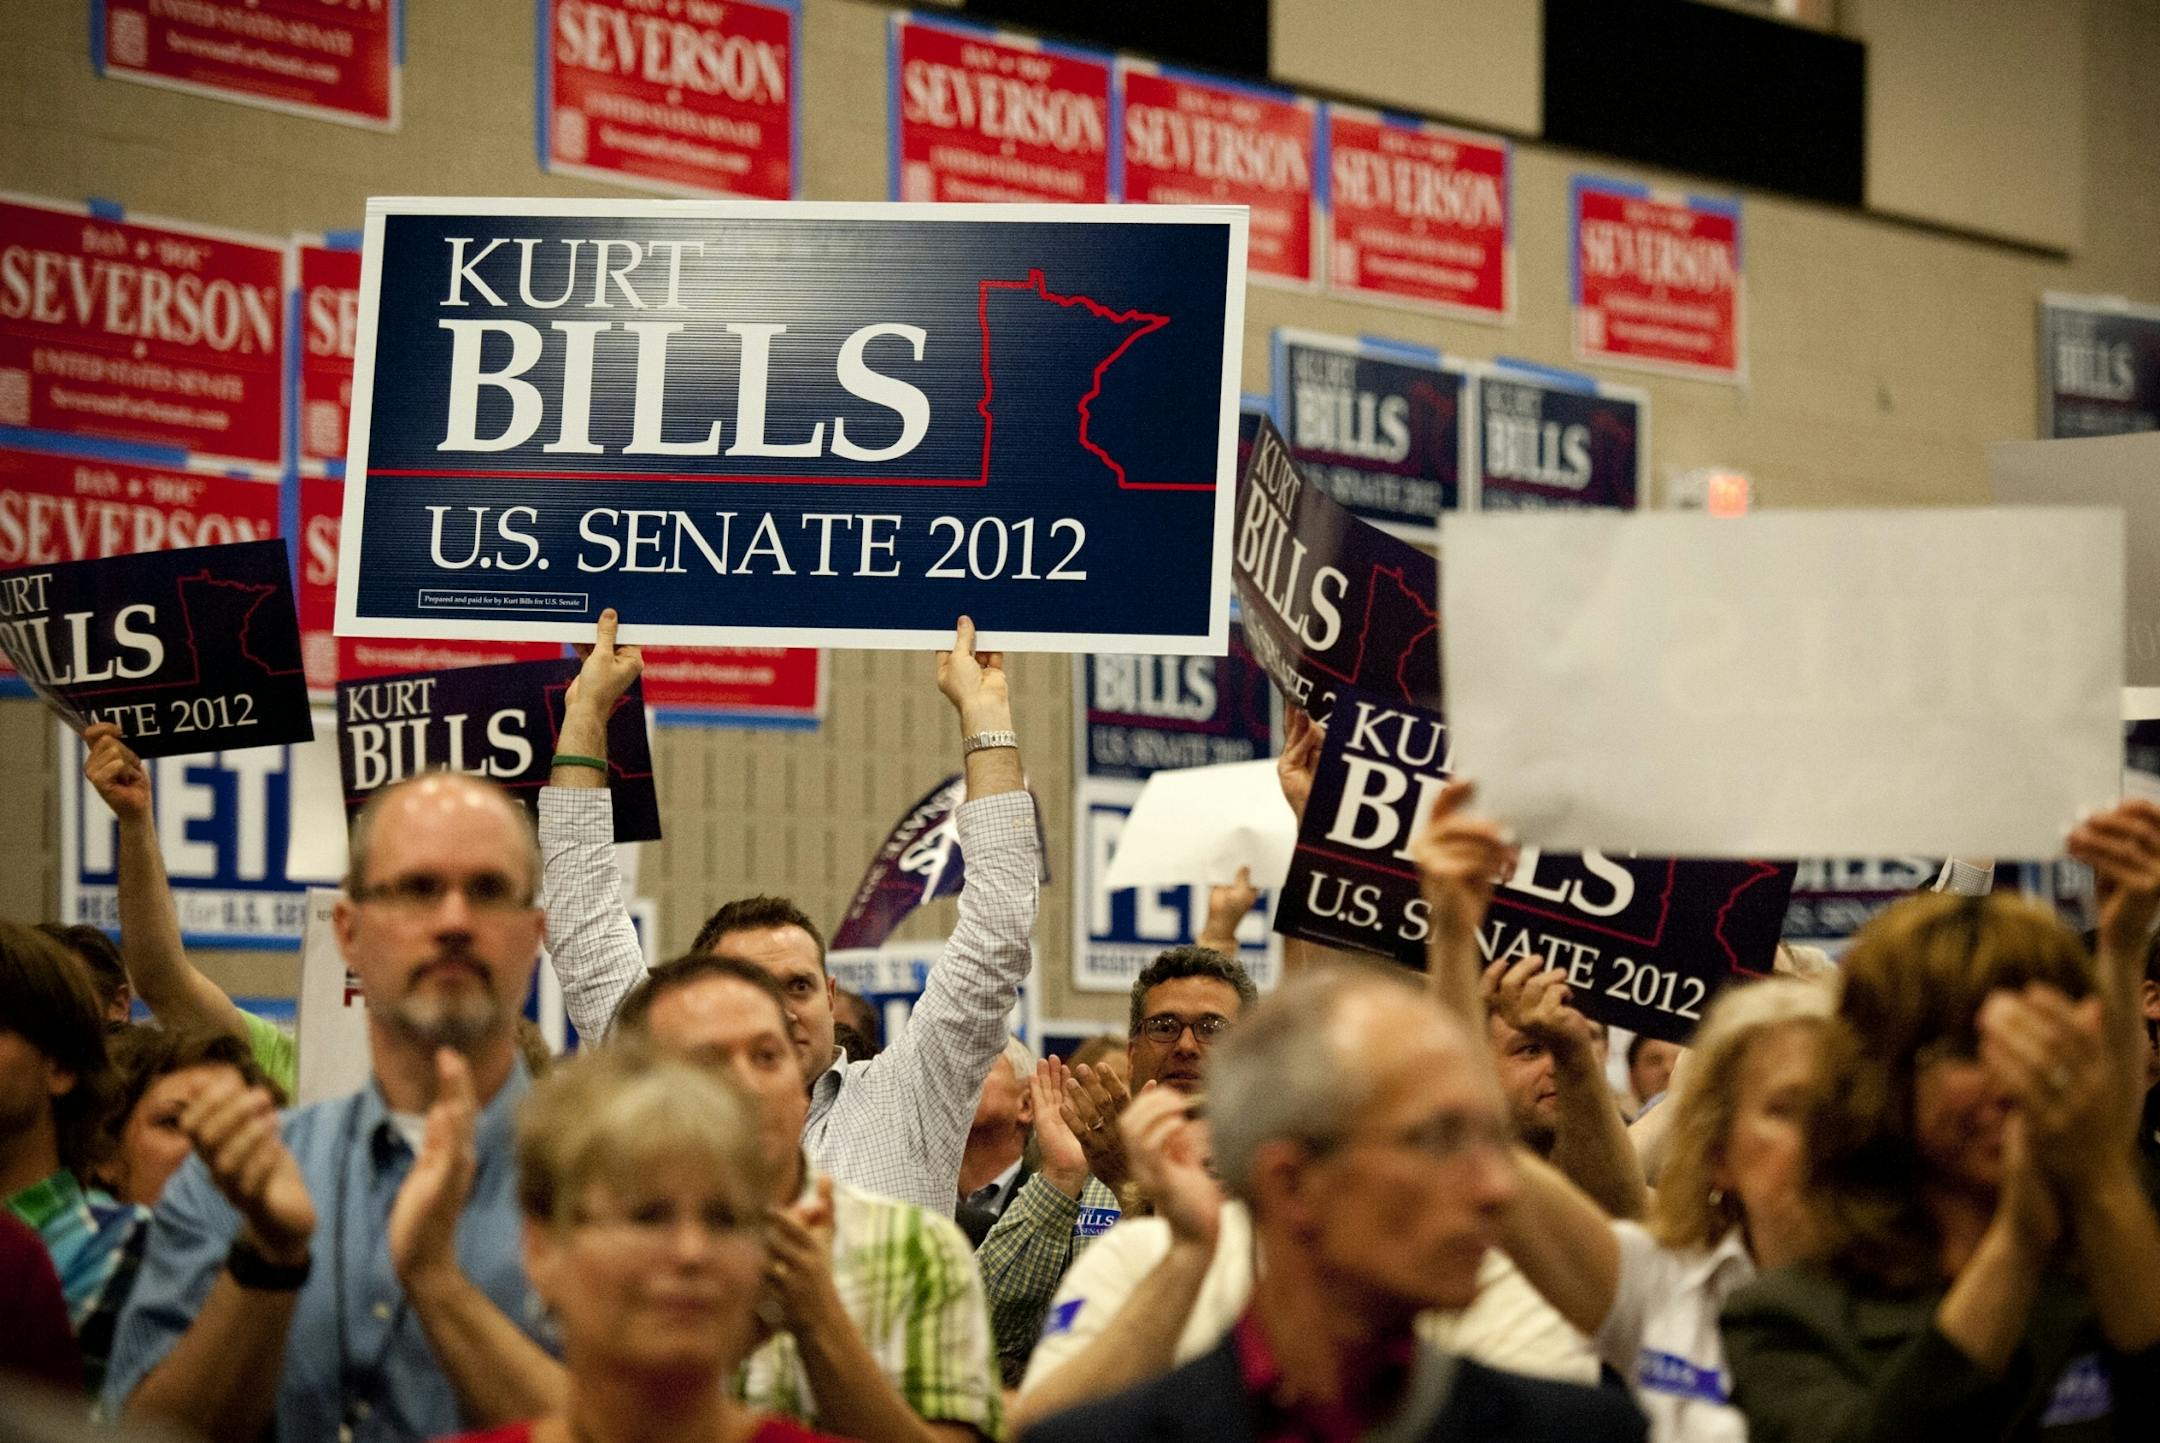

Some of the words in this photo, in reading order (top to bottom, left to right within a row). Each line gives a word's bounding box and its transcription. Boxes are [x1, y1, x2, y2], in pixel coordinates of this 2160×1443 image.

[556, 1, 786, 103] SEVERSON
[1, 244, 274, 354] SEVERSON
[439, 237, 704, 310] KURT
[437, 319, 930, 462] BILLS
[1254, 430, 1301, 520] KURT
[425, 505, 549, 571] U.S.
[576, 508, 902, 577] SENATE
[925, 516, 1087, 581] 2012
[1237, 480, 1349, 651] BILLS
[0, 574, 52, 616] URT
[424, 595, 453, 604] Prepared
[454, 595, 467, 603] and
[467, 596, 482, 605] paid
[493, 597, 502, 605] by
[534, 597, 543, 605] for
[559, 598, 580, 606] Senate
[170, 693, 258, 734] 2012
[346, 678, 436, 722] KURT
[1345, 701, 1454, 774] KU
[347, 709, 533, 791] BILLS
[1306, 870, 1383, 932] U.S.
[1605, 957, 1706, 1021] 2012
